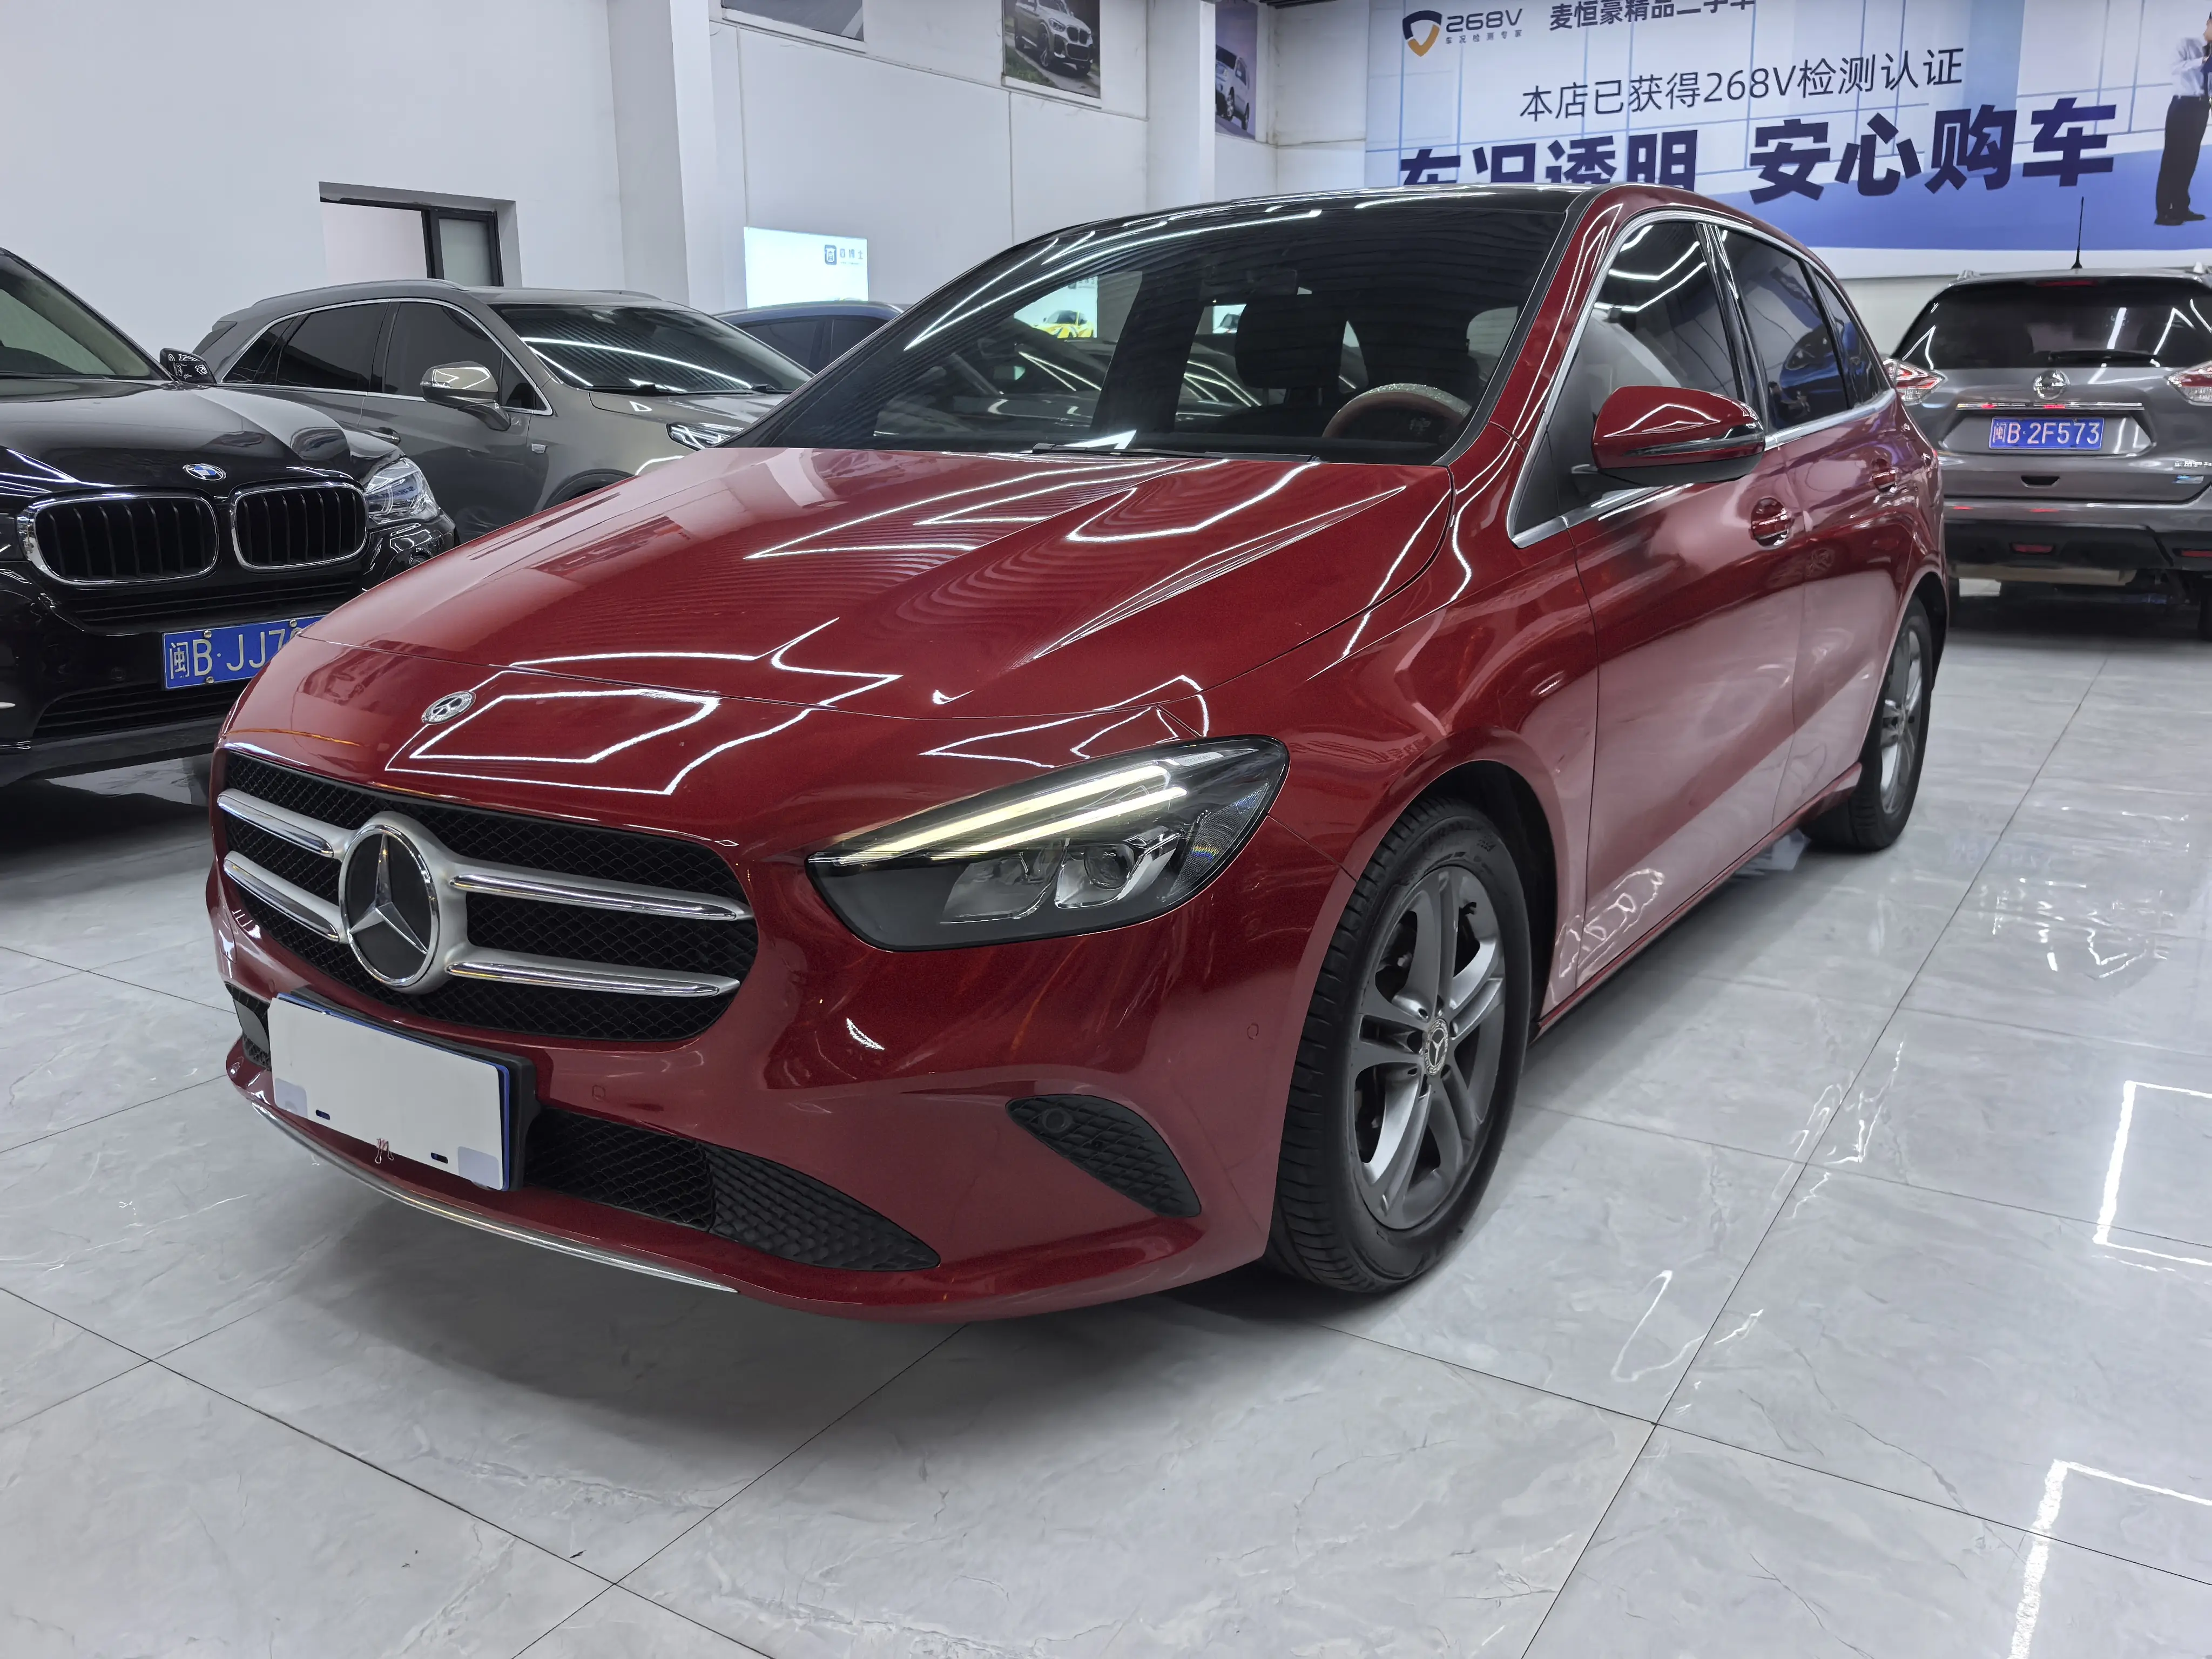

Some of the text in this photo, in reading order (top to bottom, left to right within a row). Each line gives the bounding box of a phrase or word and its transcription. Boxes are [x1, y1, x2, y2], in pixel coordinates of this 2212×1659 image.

[1446, 8, 1522, 32] 268V
[1520, 48, 1964, 122] 本店已获得268V检测认证
[1749, 97, 2116, 204] 安心购车
[169, 626, 304, 679] 闽B·JJ7
